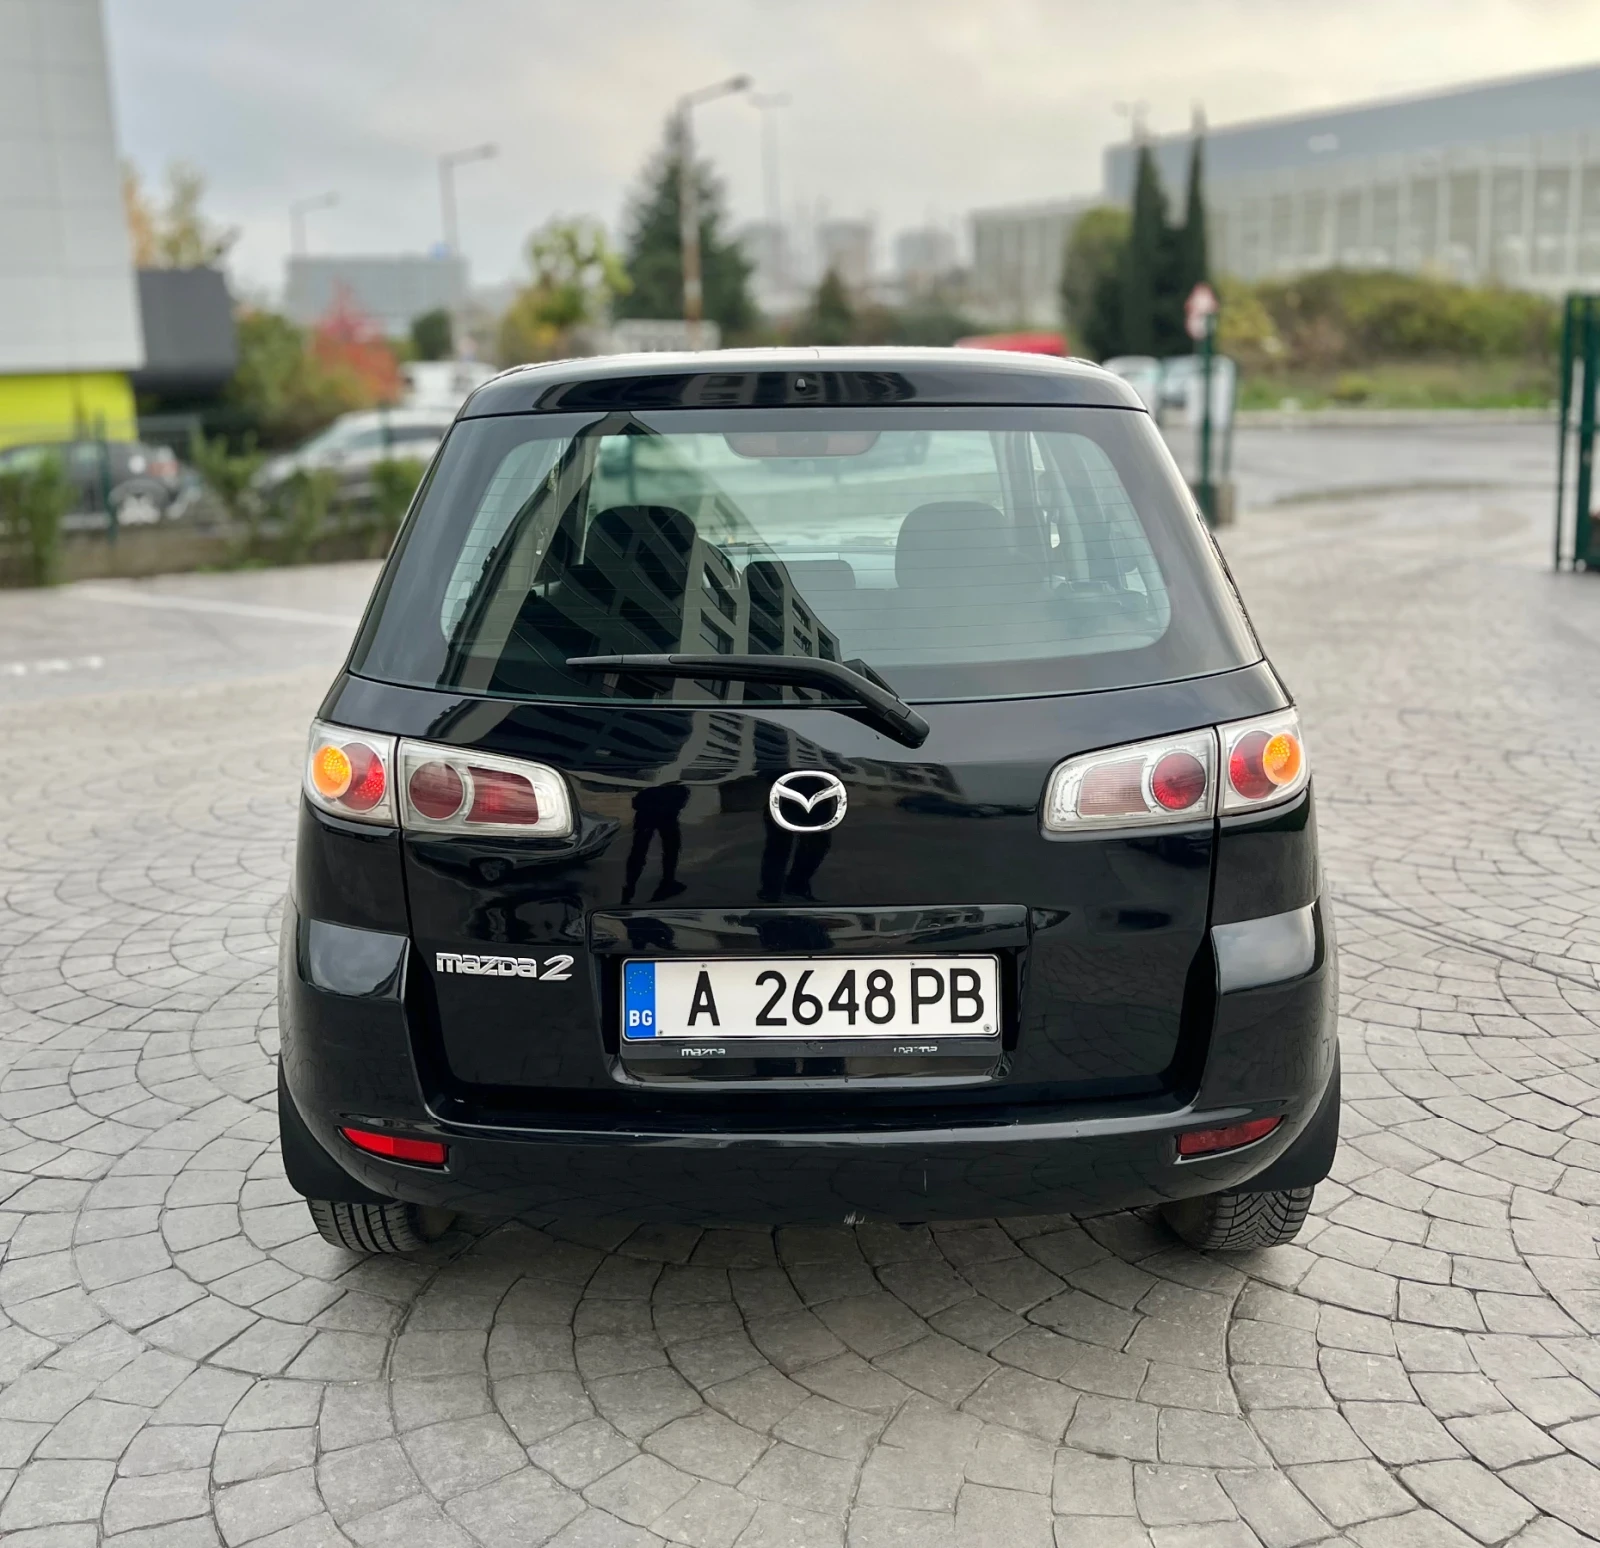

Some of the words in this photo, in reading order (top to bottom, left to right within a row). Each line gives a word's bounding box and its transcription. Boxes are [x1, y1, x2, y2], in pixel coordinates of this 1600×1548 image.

[687, 971, 720, 1027] A
[755, 969, 896, 1027] 2648
[910, 968, 985, 1025] PB
[629, 1010, 653, 1027] BG
